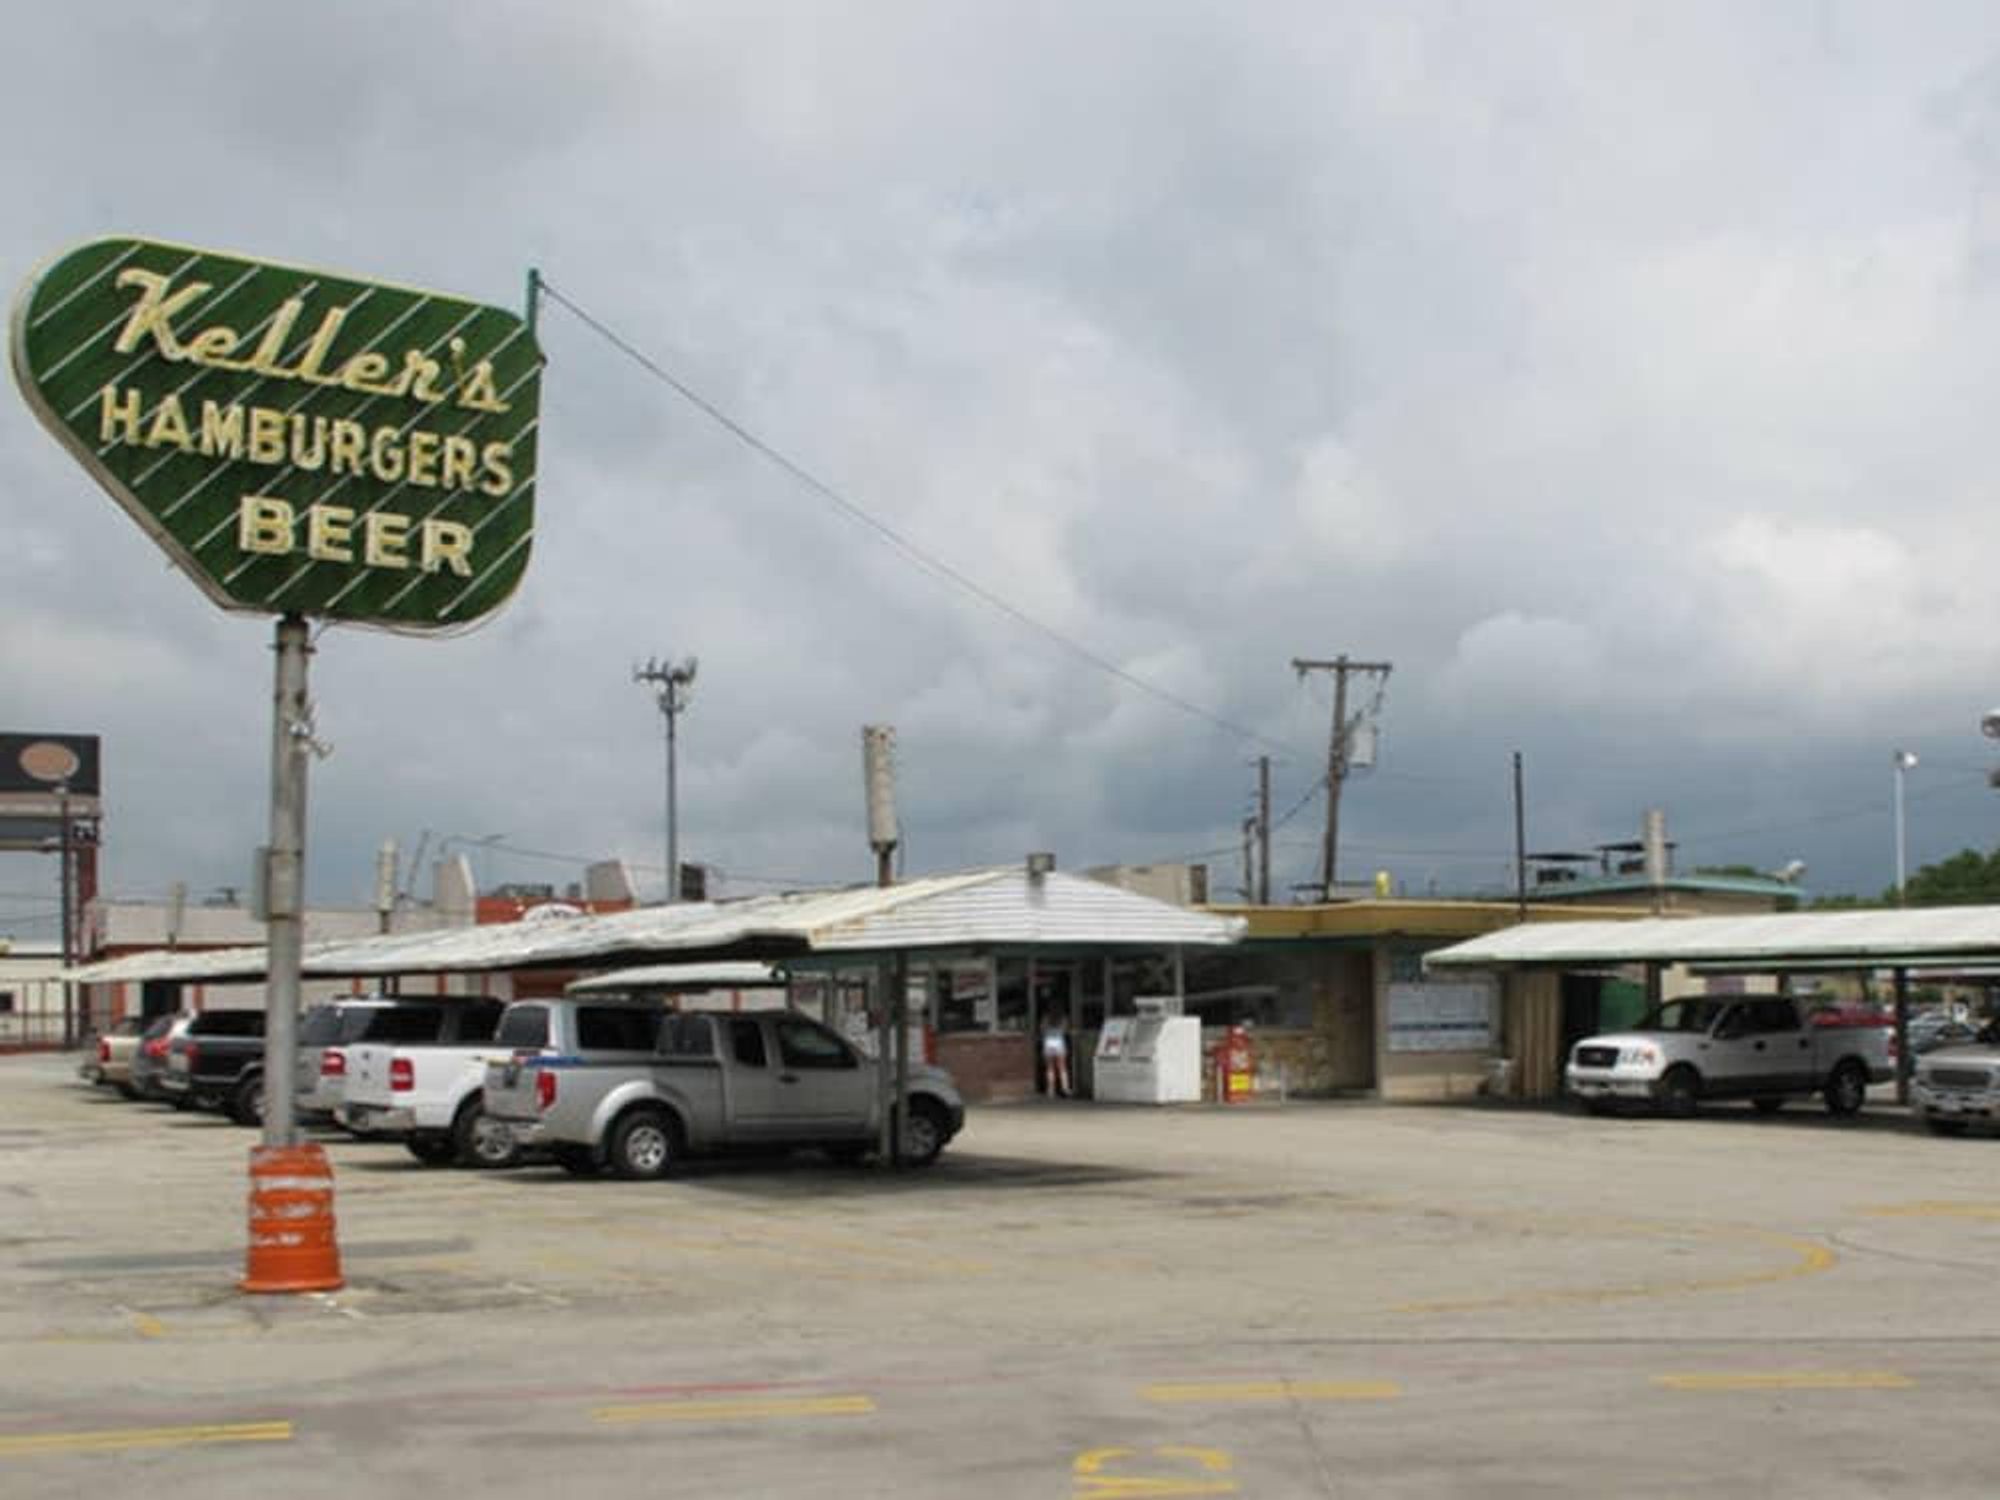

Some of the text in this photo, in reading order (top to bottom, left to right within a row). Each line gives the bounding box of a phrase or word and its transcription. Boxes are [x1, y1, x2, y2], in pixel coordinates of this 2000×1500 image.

[115, 269, 512, 412] Keller's
[101, 385, 514, 496] HAMBURGERS
[239, 496, 473, 577] BEER
